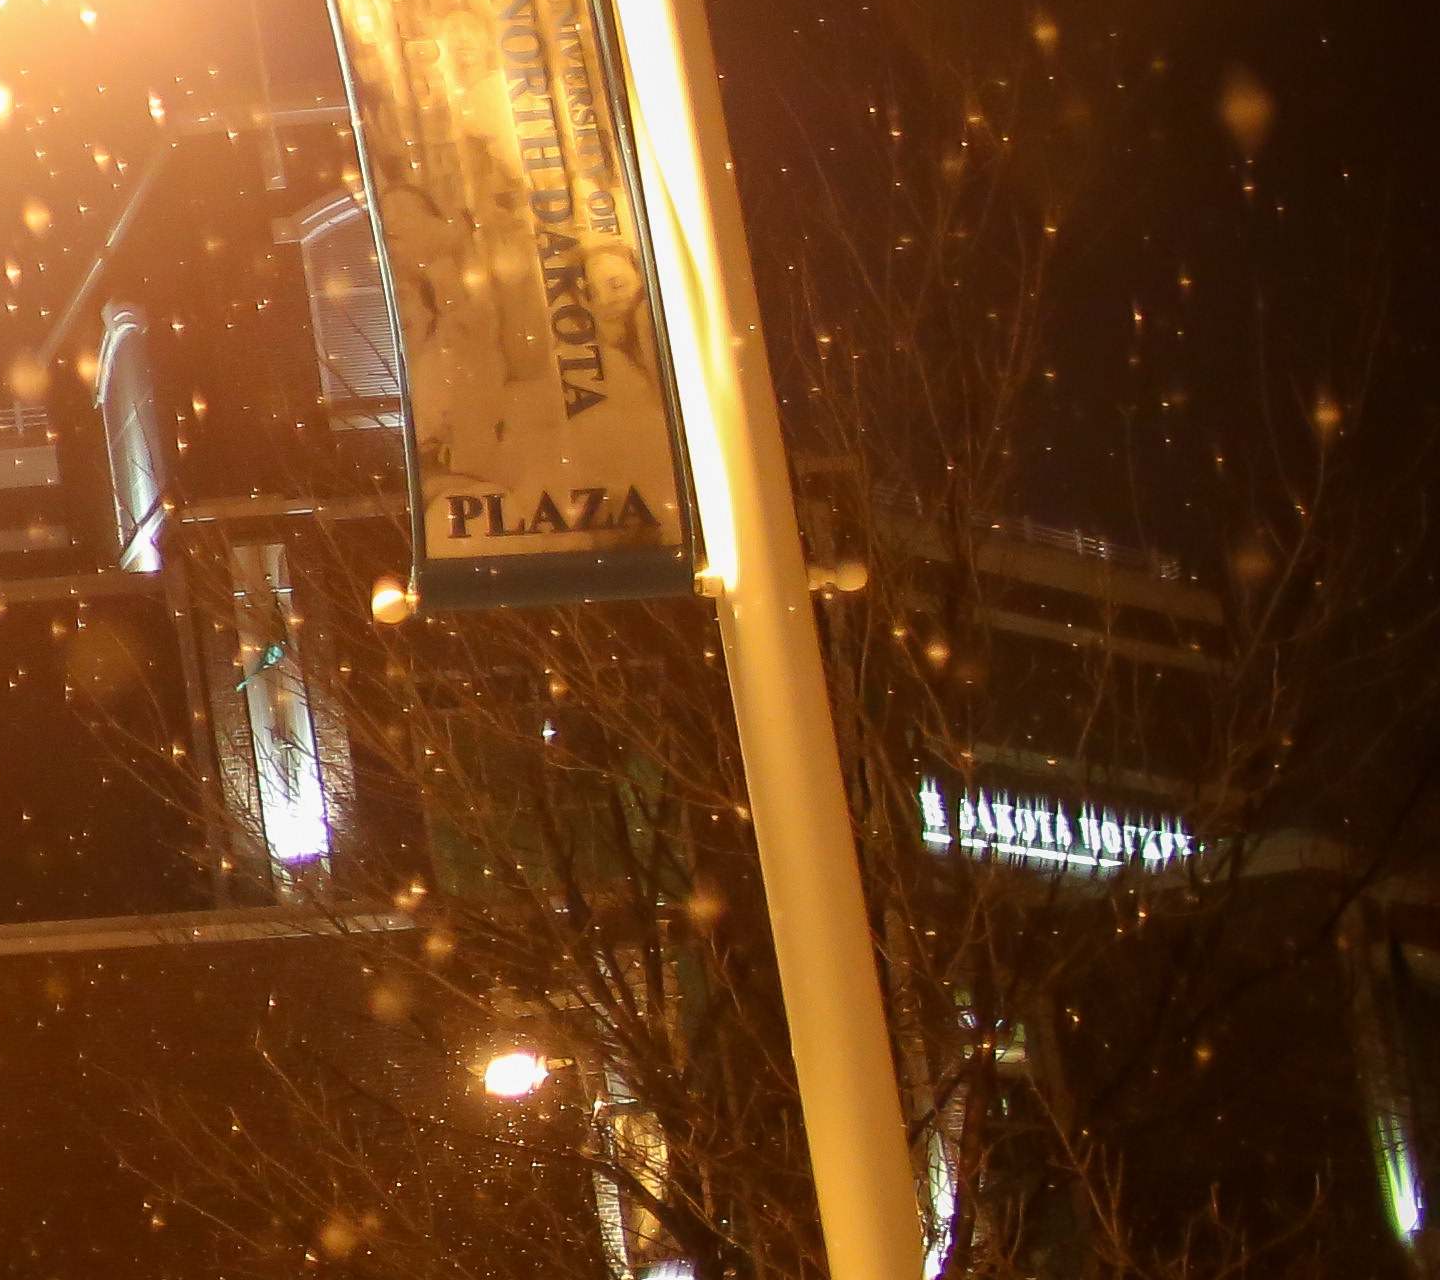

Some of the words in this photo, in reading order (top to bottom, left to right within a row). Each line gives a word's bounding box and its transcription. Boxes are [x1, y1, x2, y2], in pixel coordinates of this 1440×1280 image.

[586, 190, 622, 236] OF
[532, 188, 607, 419] DAKOTA
[445, 484, 662, 539] PLAZA
